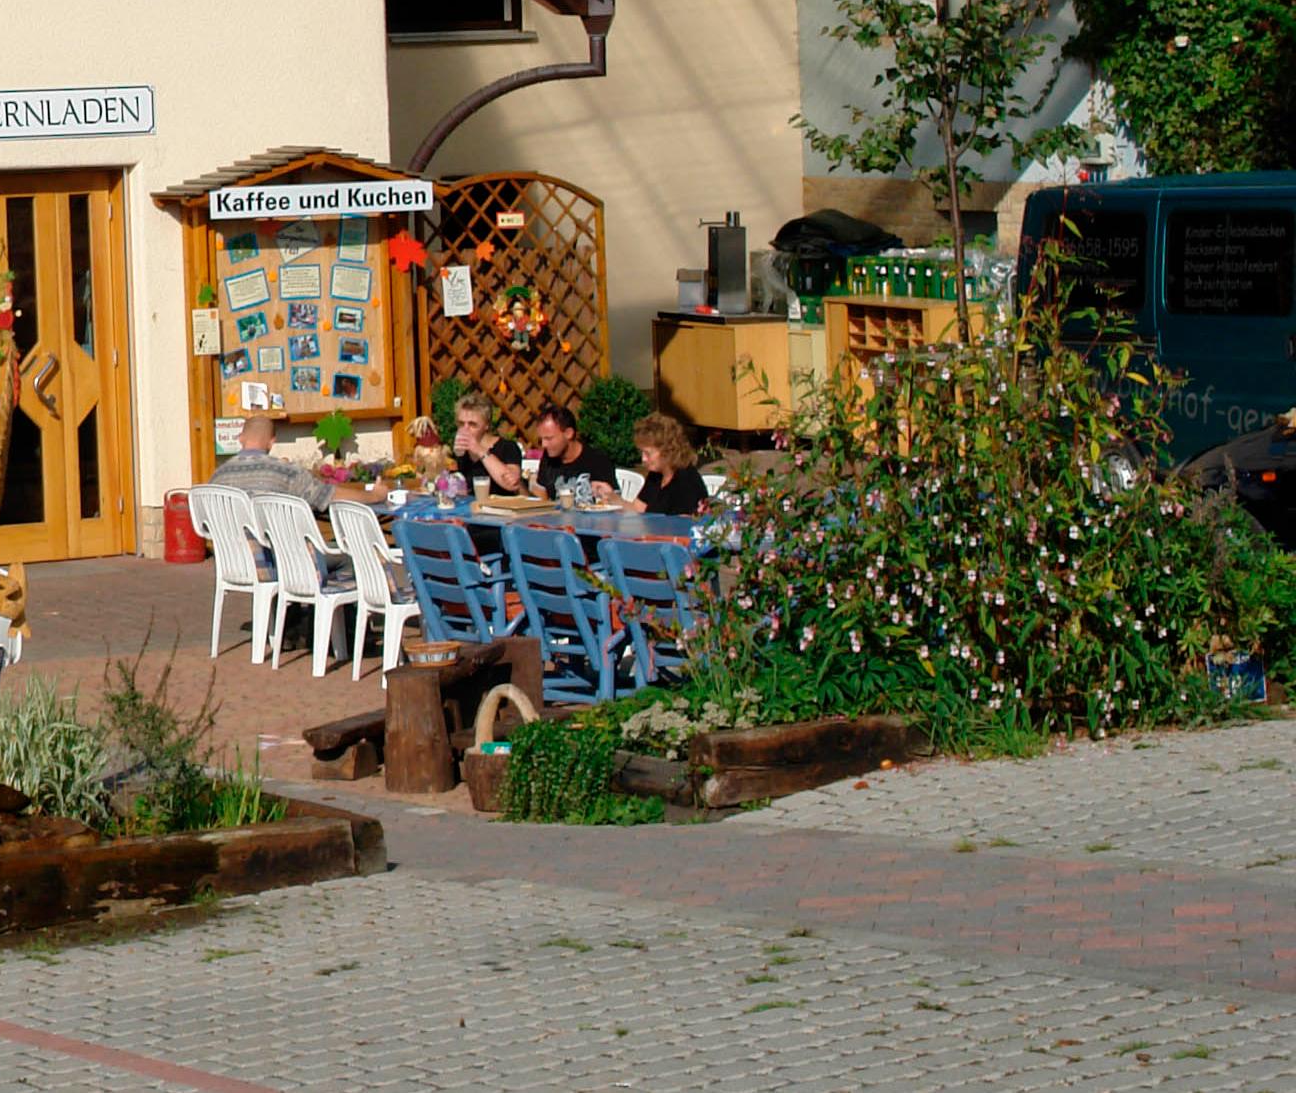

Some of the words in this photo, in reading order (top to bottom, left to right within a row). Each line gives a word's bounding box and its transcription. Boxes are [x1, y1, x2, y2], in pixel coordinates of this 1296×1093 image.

[216, 192, 291, 213] Kaffee
[299, 189, 340, 210] und
[347, 187, 427, 207] Kuchen
